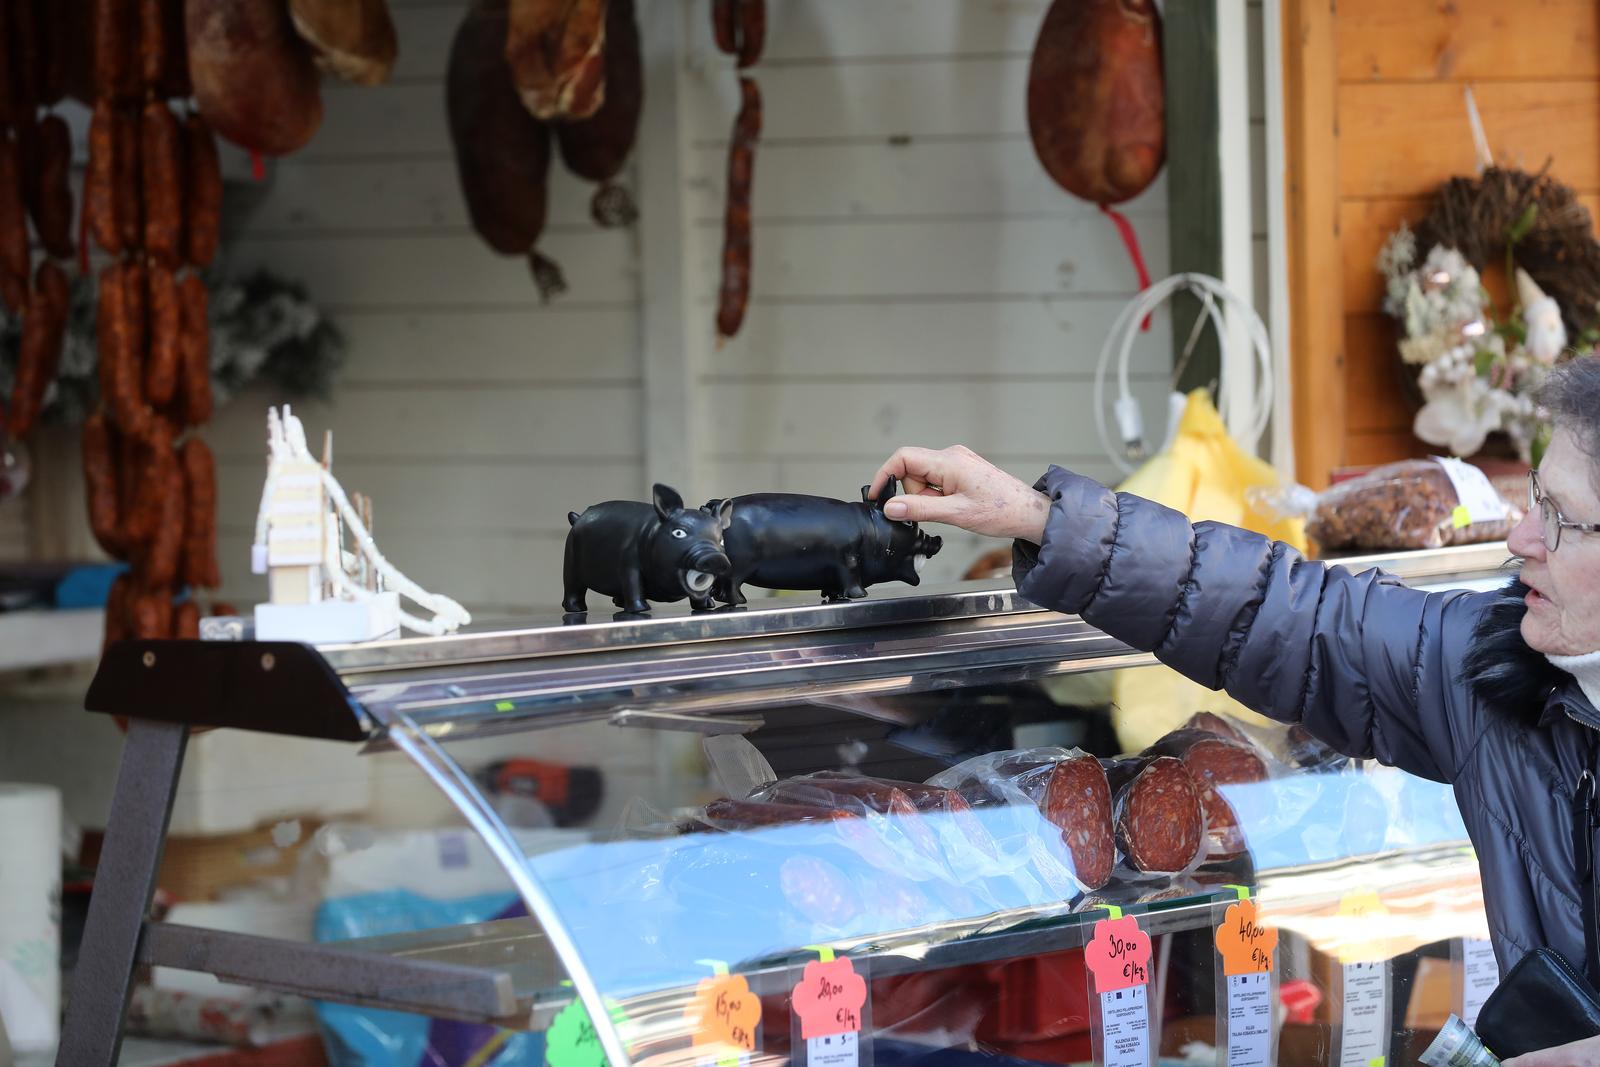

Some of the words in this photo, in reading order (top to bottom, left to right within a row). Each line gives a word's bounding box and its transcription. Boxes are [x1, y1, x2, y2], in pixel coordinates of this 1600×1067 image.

[1239, 917, 1265, 945] 40,00
[1108, 934, 1137, 960] 30,00
[1123, 960, 1145, 983] €/kg
[817, 976, 843, 1001] 20,00
